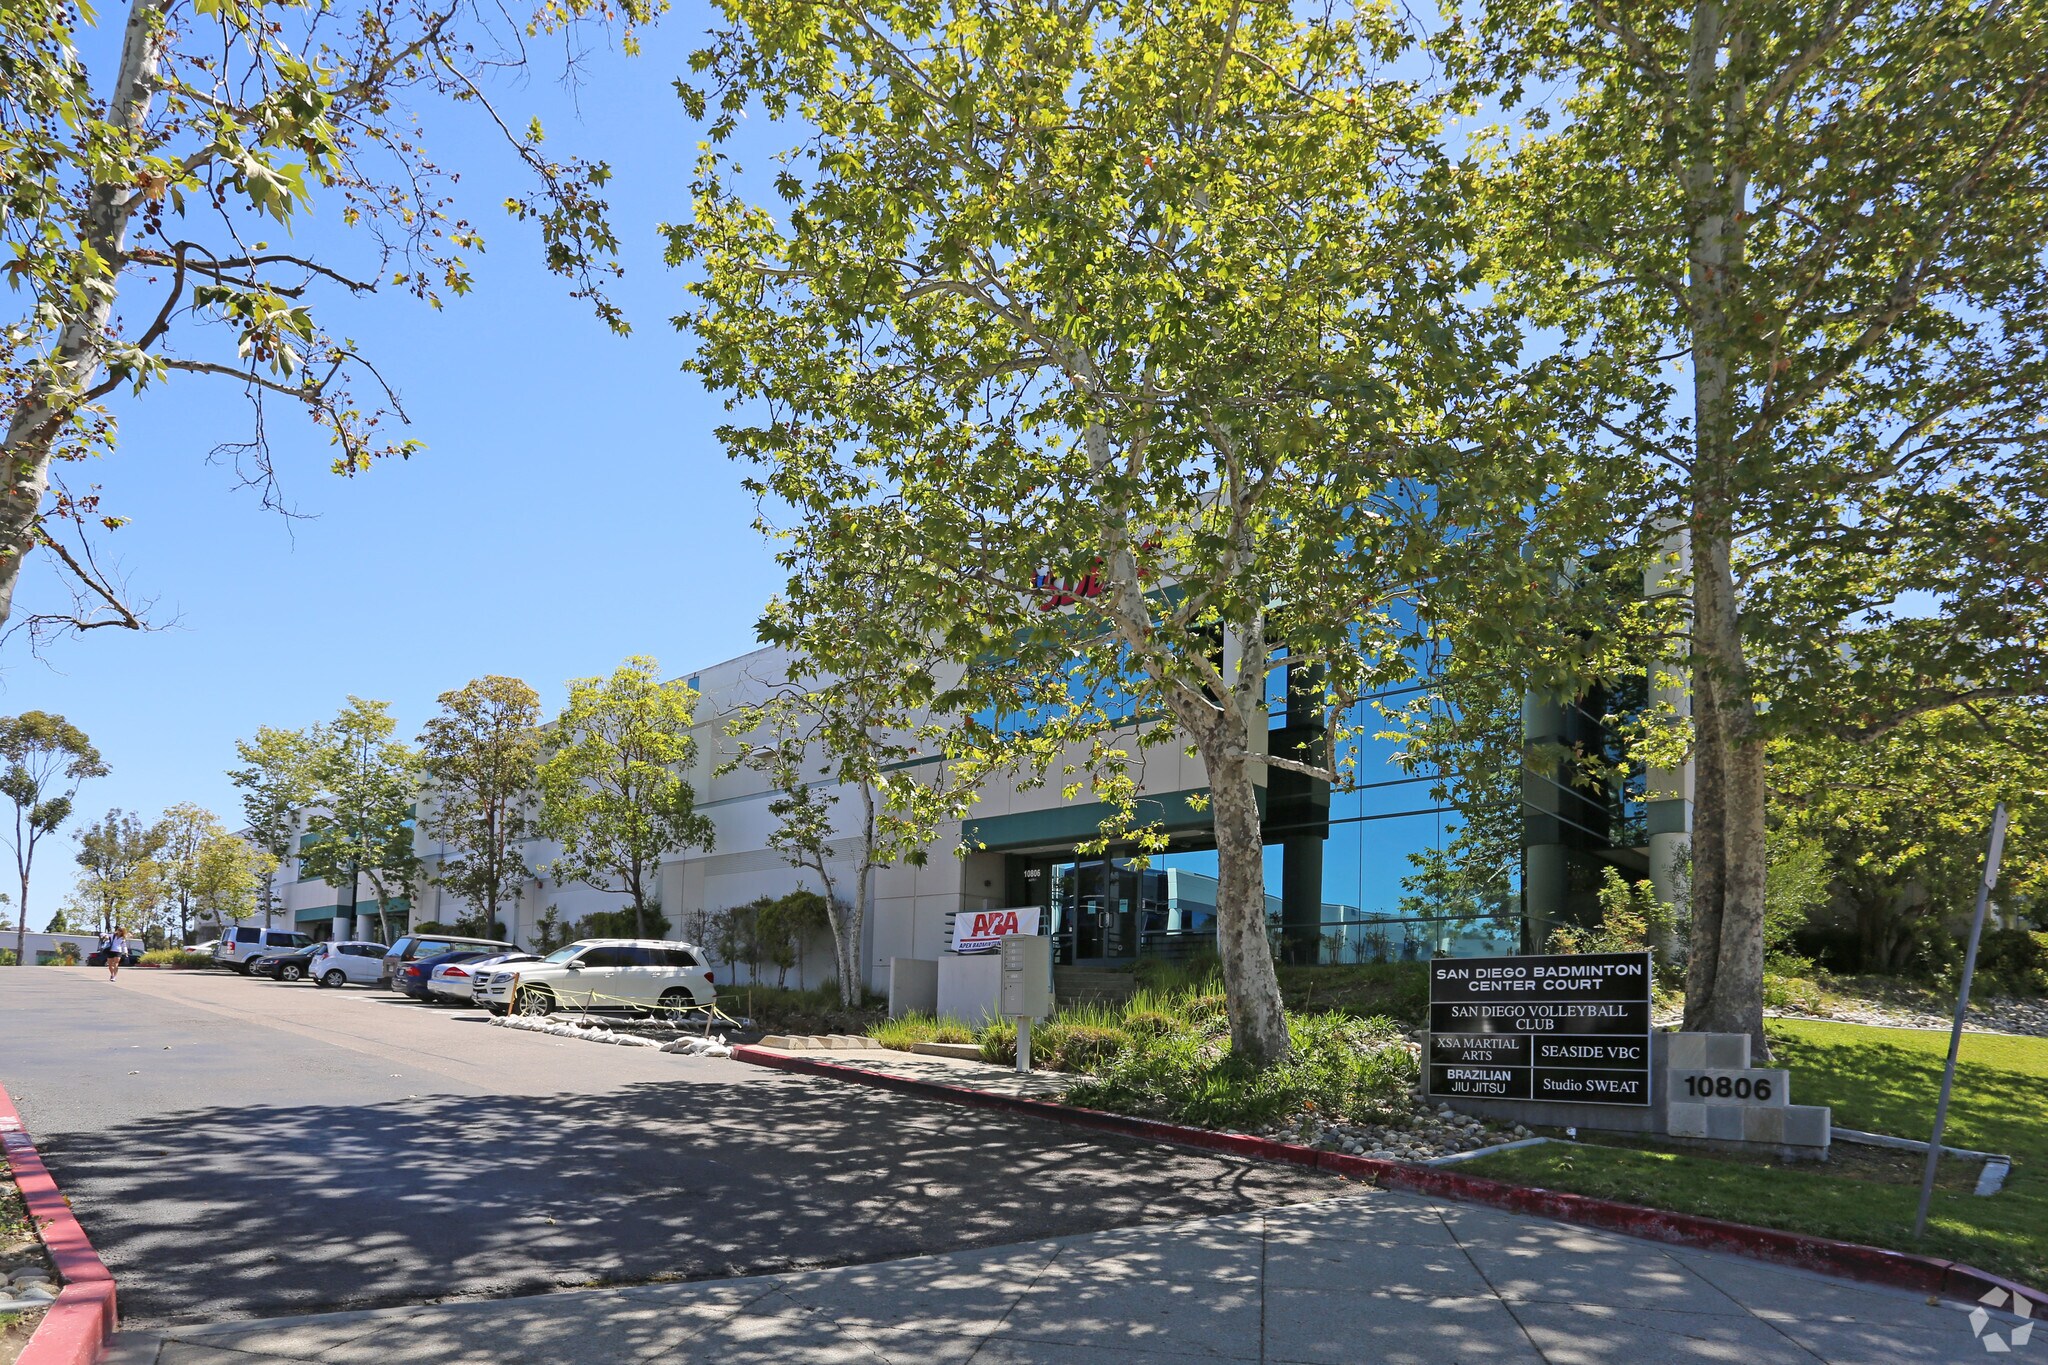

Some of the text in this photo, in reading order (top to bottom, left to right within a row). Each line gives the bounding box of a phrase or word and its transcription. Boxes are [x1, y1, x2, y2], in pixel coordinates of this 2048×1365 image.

[1024, 869, 1041, 878] 10806
[1436, 964, 1642, 980] SAN DIEGO BADMINTON
[1468, 978, 1603, 992] CENTER COURT
[1451, 1005, 1629, 1017] SAN DIEGO VOLLEYBALL
[1516, 1018, 1555, 1030] CLUB
[1437, 1038, 1519, 1050] XSA MARTIAL
[1461, 1050, 1493, 1061] ARTS
[1541, 1045, 1640, 1060] SEASIDE VBC
[1447, 1069, 1512, 1081] BRAZILIAN
[1451, 1082, 1506, 1094] JIU JITSU
[1543, 1078, 1639, 1093] Studio SWEAT
[1684, 1075, 1772, 1101] 10806
